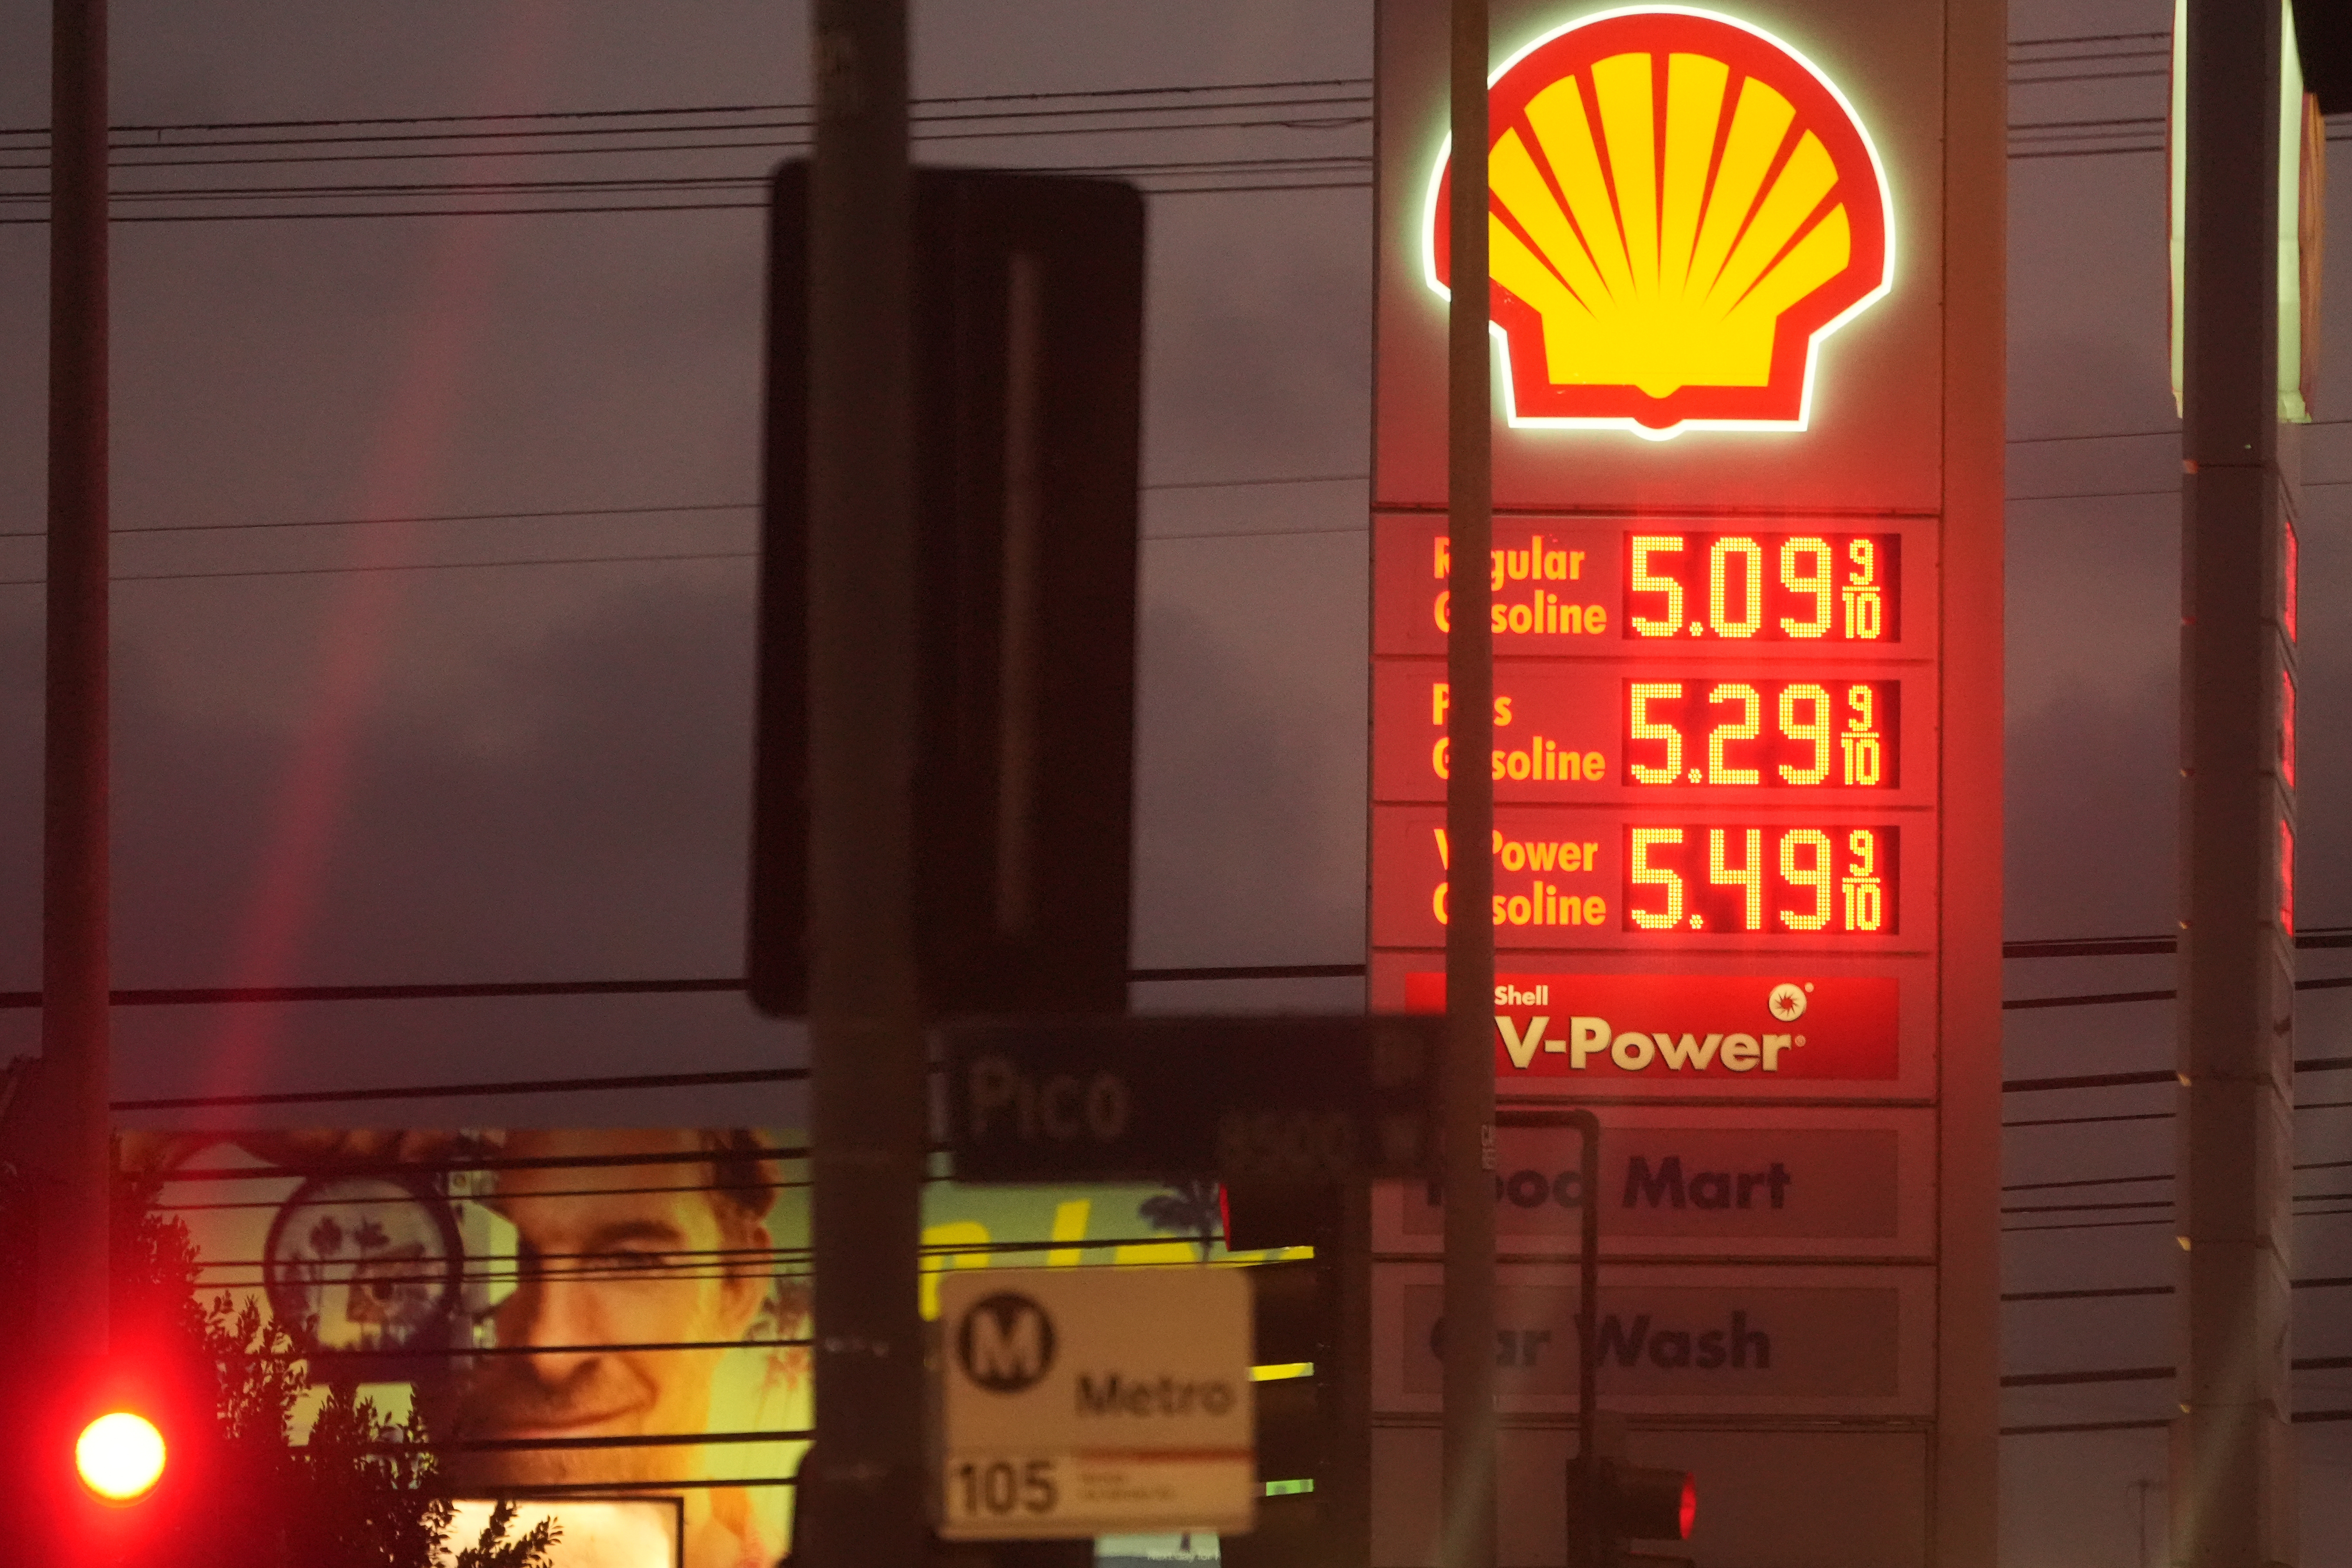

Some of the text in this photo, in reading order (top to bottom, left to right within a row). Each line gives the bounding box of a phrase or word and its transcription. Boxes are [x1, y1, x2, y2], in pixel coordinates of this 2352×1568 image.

[1434, 535, 1586, 592] Rgular
[1632, 536, 1832, 638] 5.09
[1434, 589, 1607, 635] Gsoline
[1433, 683, 1512, 727] Ps
[1432, 736, 1606, 781] Gsoline
[1631, 683, 1830, 785] 5.29
[1631, 828, 1831, 930] 5.49
[1494, 984, 1549, 1006] Shell
[1494, 1015, 1792, 1072] V-Power
[1621, 1155, 1791, 1210] Mart
[1572, 1310, 1772, 1370] Wash
[1074, 1372, 1236, 1419] Metro
[956, 1459, 1059, 1517] 105
